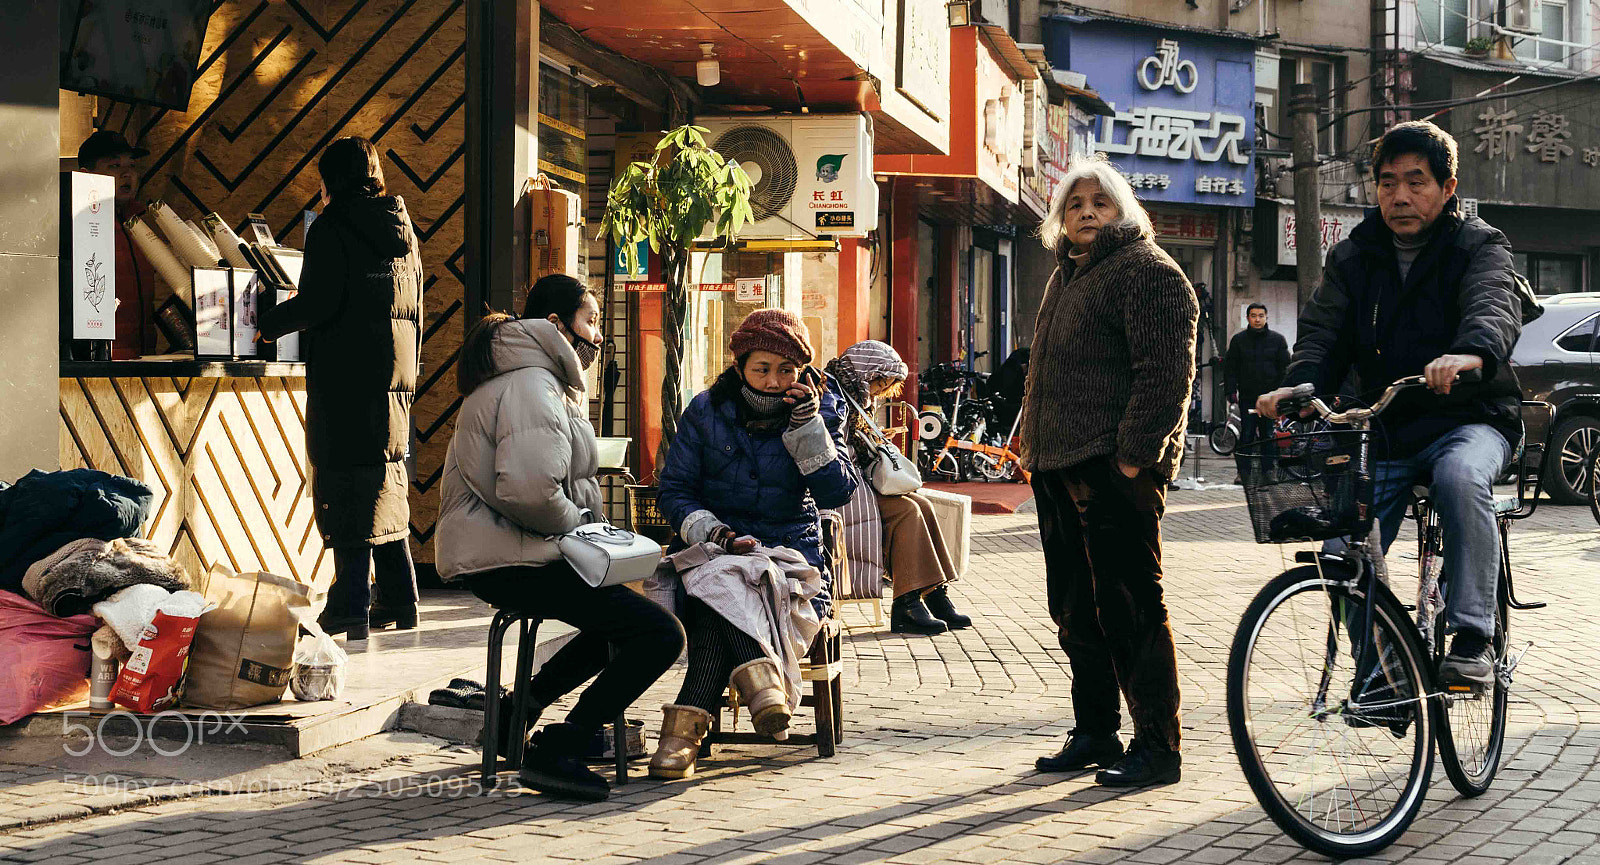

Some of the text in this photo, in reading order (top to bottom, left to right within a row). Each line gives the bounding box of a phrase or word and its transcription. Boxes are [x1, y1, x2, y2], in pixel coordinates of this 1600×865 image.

[1095, 102, 1250, 165] 上海永久
[1195, 174, 1246, 195] 自行车
[812, 190, 843, 201] 长虹
[753, 283, 763, 295] 推
[100, 664, 114, 672] WE
